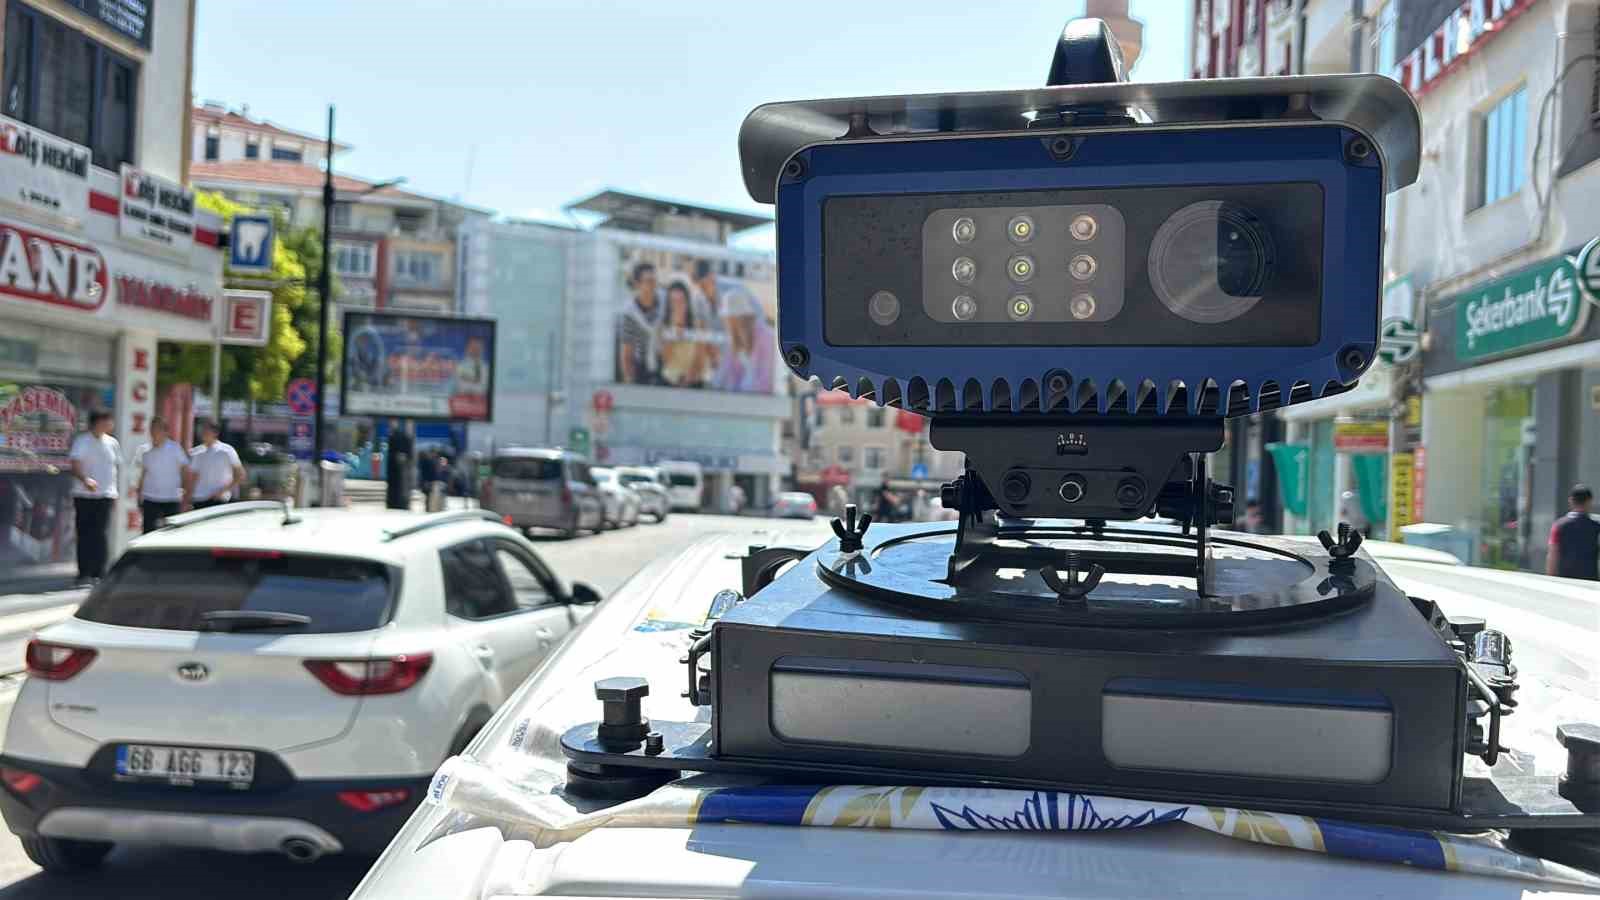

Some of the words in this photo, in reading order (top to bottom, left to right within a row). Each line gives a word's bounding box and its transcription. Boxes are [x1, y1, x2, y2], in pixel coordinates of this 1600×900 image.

[233, 303, 257, 331] E
[1466, 275, 1547, 350] Şekerbank
[216, 751, 253, 777] 123
